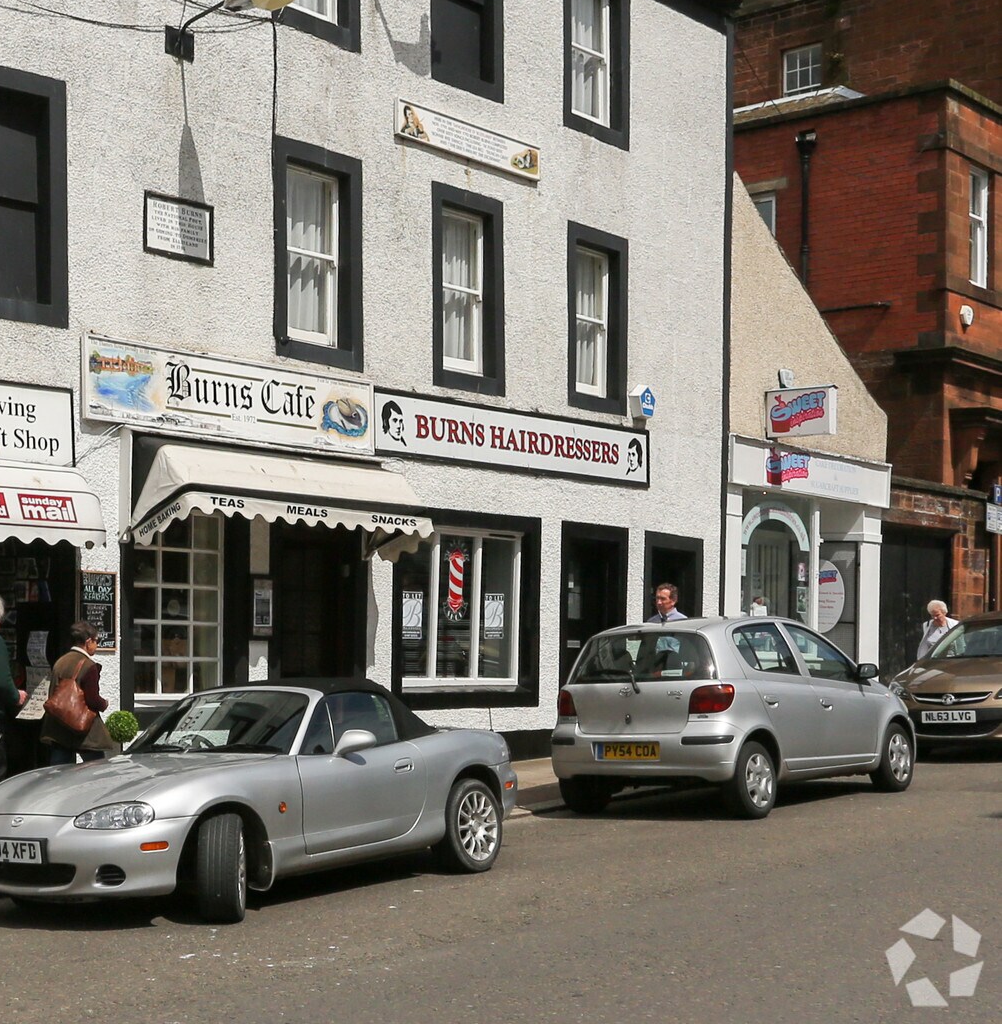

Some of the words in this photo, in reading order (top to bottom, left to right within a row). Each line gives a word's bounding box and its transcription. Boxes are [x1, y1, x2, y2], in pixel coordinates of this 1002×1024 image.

[165, 361, 252, 410] Burns
[261, 379, 316, 419] Cafe
[770, 391, 826, 421] SWEET
[243, 416, 257, 424] 1972
[13, 429, 60, 456] Shop
[415, 414, 485, 447] BURNS
[490, 425, 620, 465] HAIRDRESSERS
[766, 453, 810, 473] SWEET
[21, 496, 63, 507] sunday
[210, 496, 245, 509] TEAS
[23, 500, 76, 522] mail
[139, 519, 158, 537] HOME
[156, 502, 181, 524] BAKING
[286, 505, 328, 517] MEALS
[371, 514, 417, 527] SNACKS
[926, 712, 949, 721] NL63
[951, 712, 971, 721] LVG
[605, 744, 632, 757] PY54
[12, 842, 36, 859] XFD
